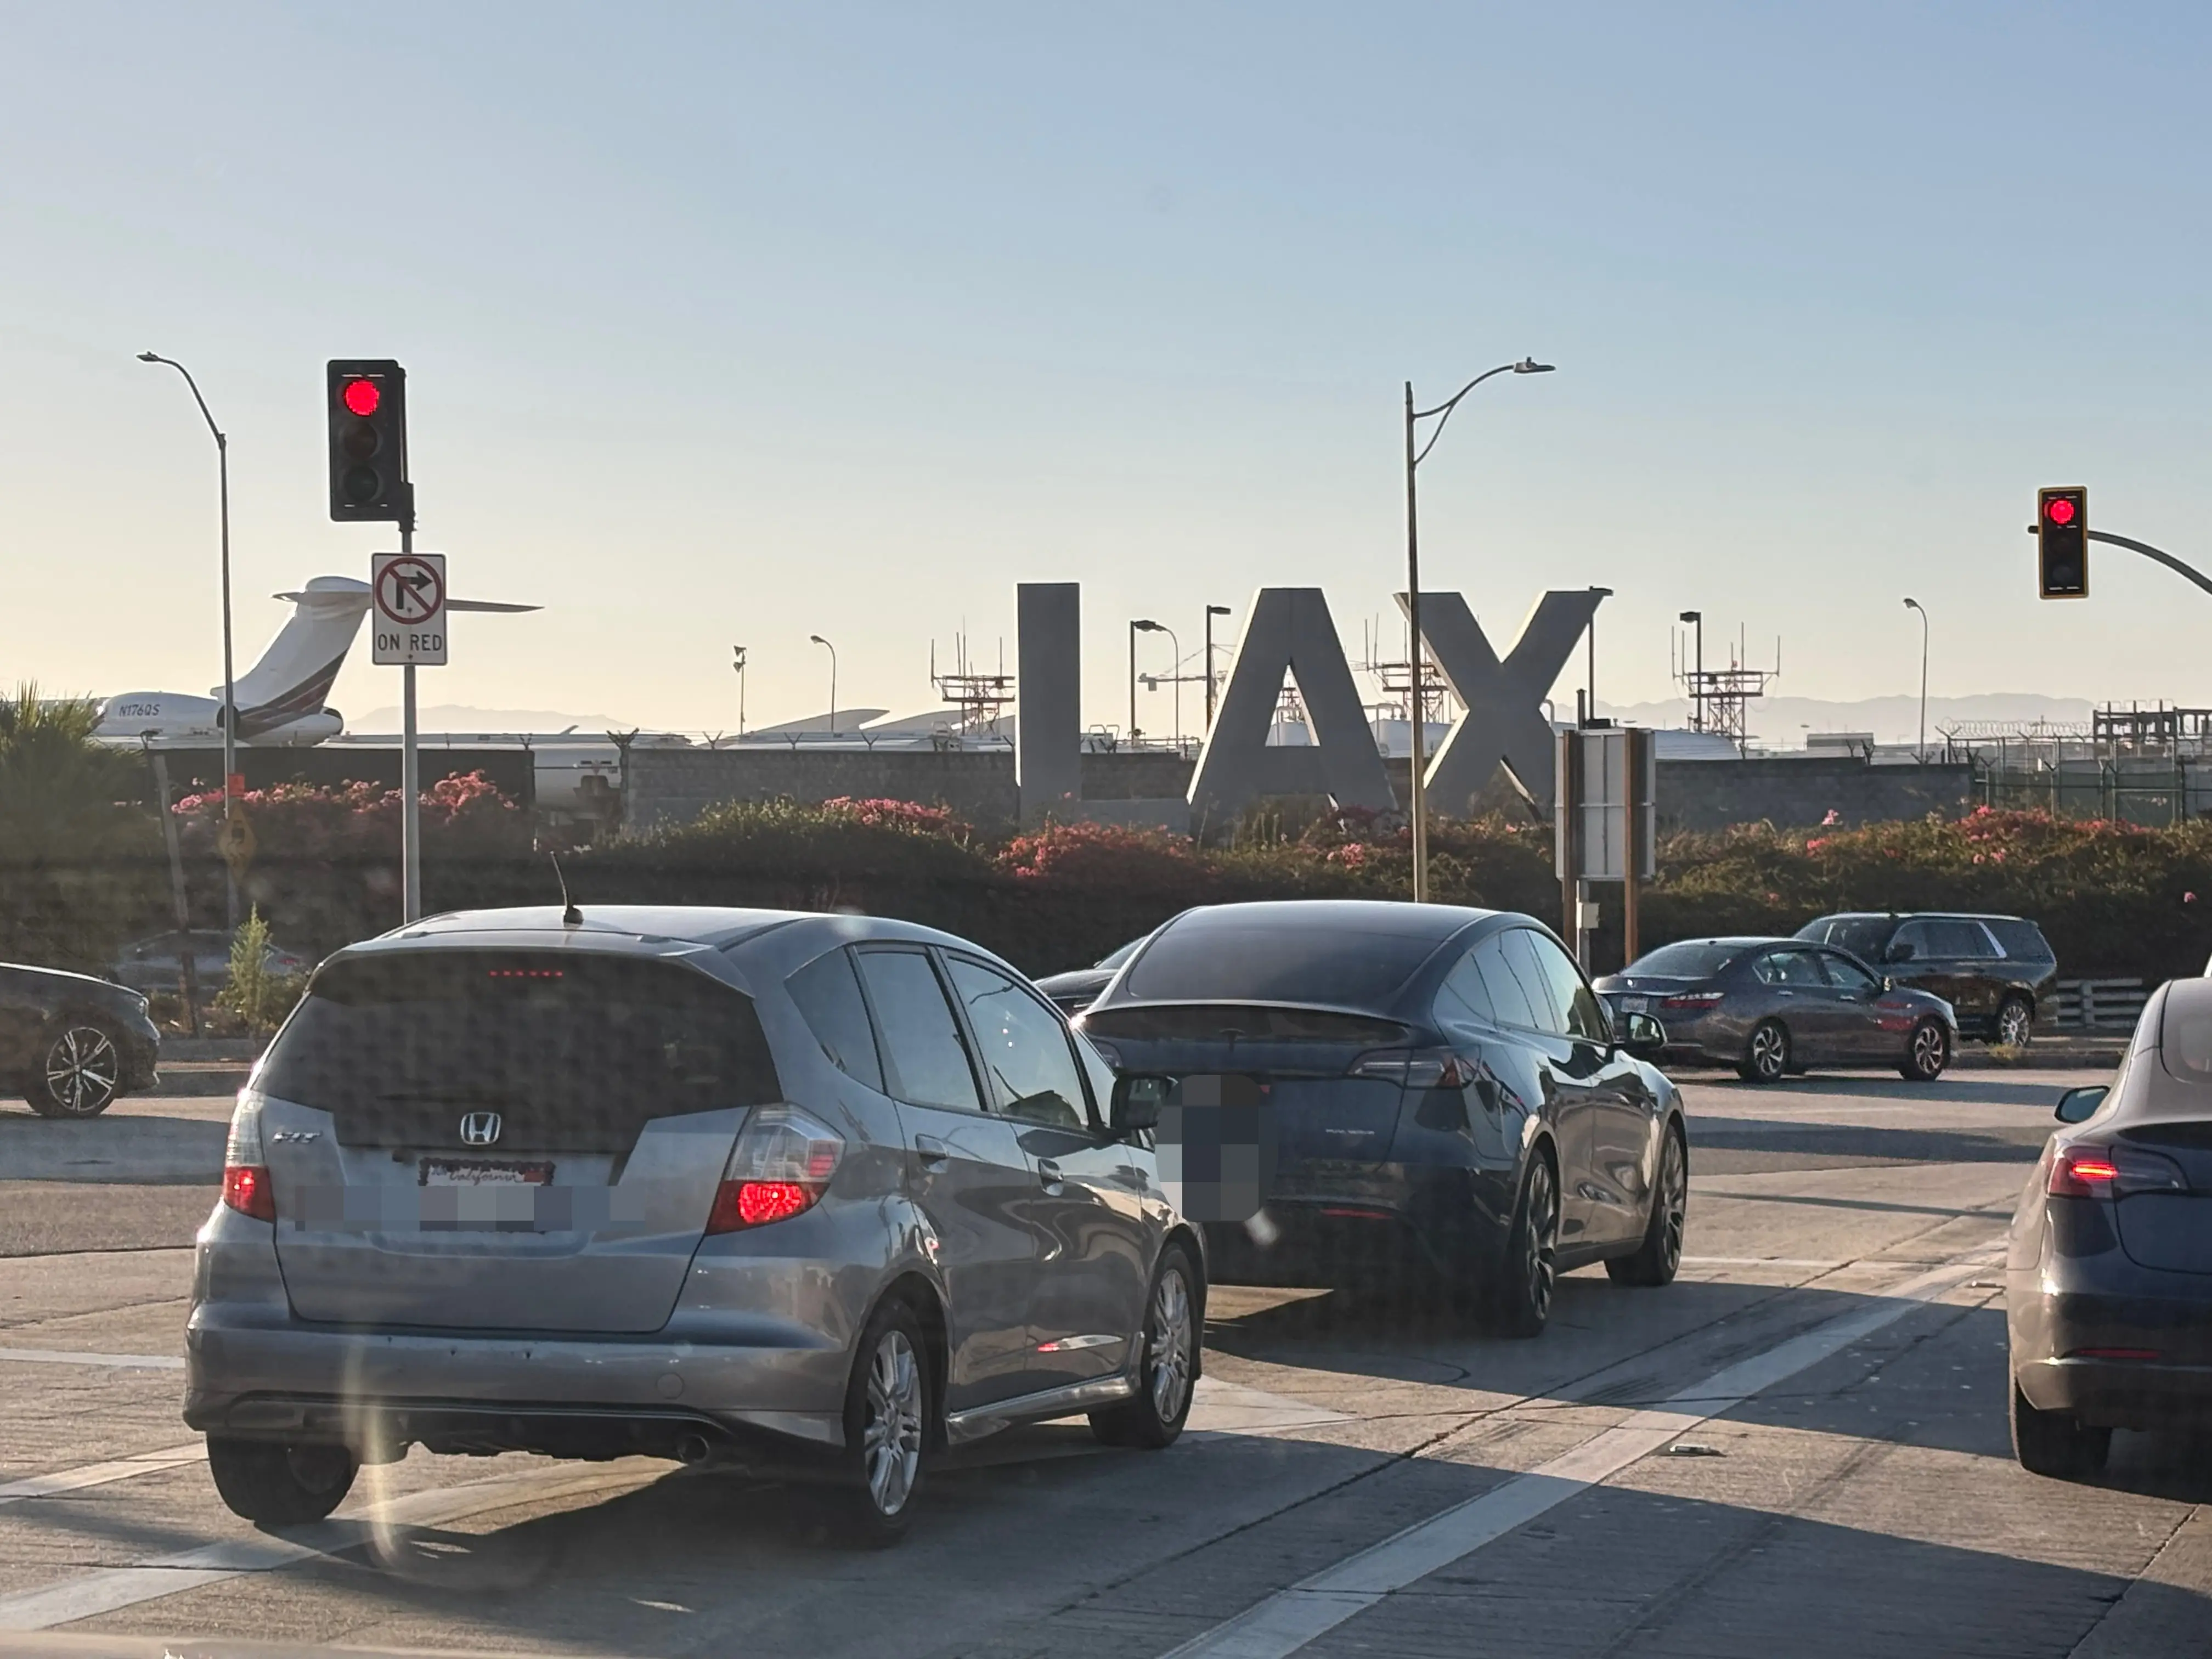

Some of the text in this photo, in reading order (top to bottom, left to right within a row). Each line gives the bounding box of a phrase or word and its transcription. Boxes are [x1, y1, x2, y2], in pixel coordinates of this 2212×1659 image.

[377, 634, 442, 651] ON RED
[119, 704, 161, 718] N176QS
[1016, 583, 1606, 835] LAX
